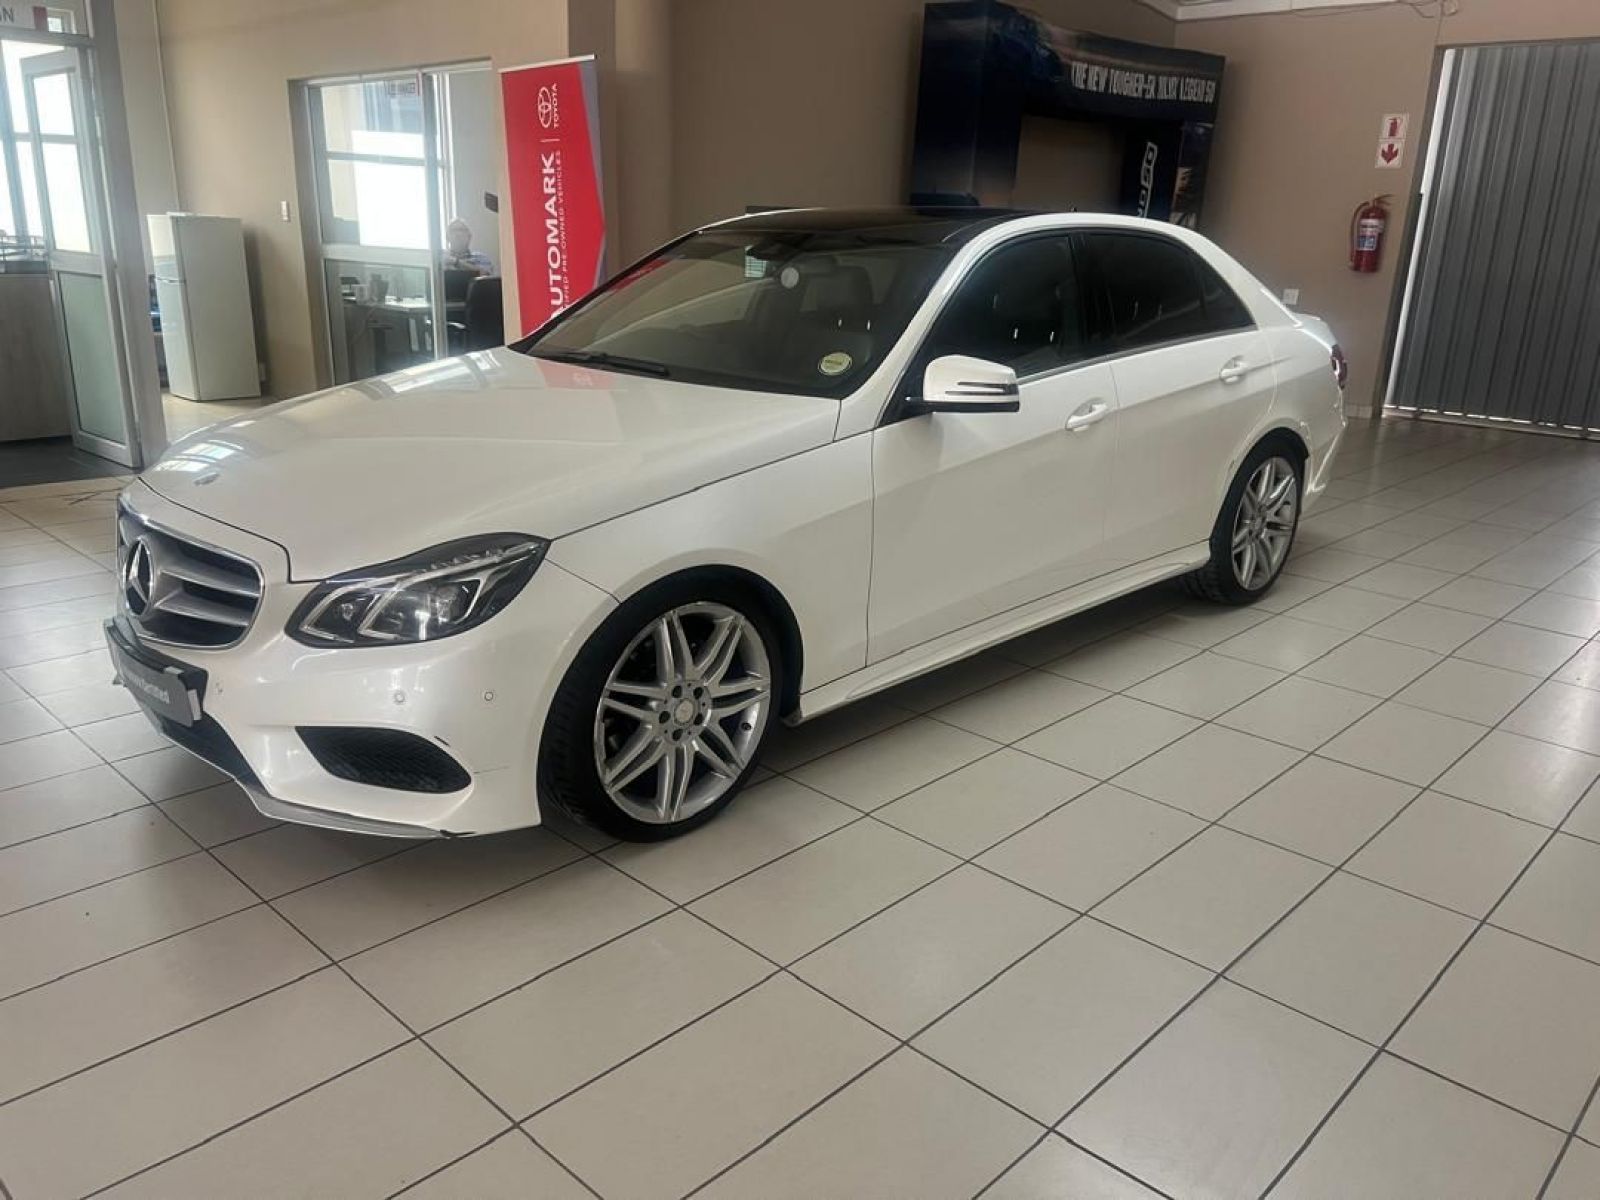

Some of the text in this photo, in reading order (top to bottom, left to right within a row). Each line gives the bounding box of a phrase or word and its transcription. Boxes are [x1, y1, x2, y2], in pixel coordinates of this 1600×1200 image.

[1071, 61, 1088, 90] THE
[1088, 64, 1109, 93] NEW
[552, 83, 560, 129] TOYOTA
[555, 150, 564, 204] VEHICLES
[559, 206, 567, 250] OWNED
